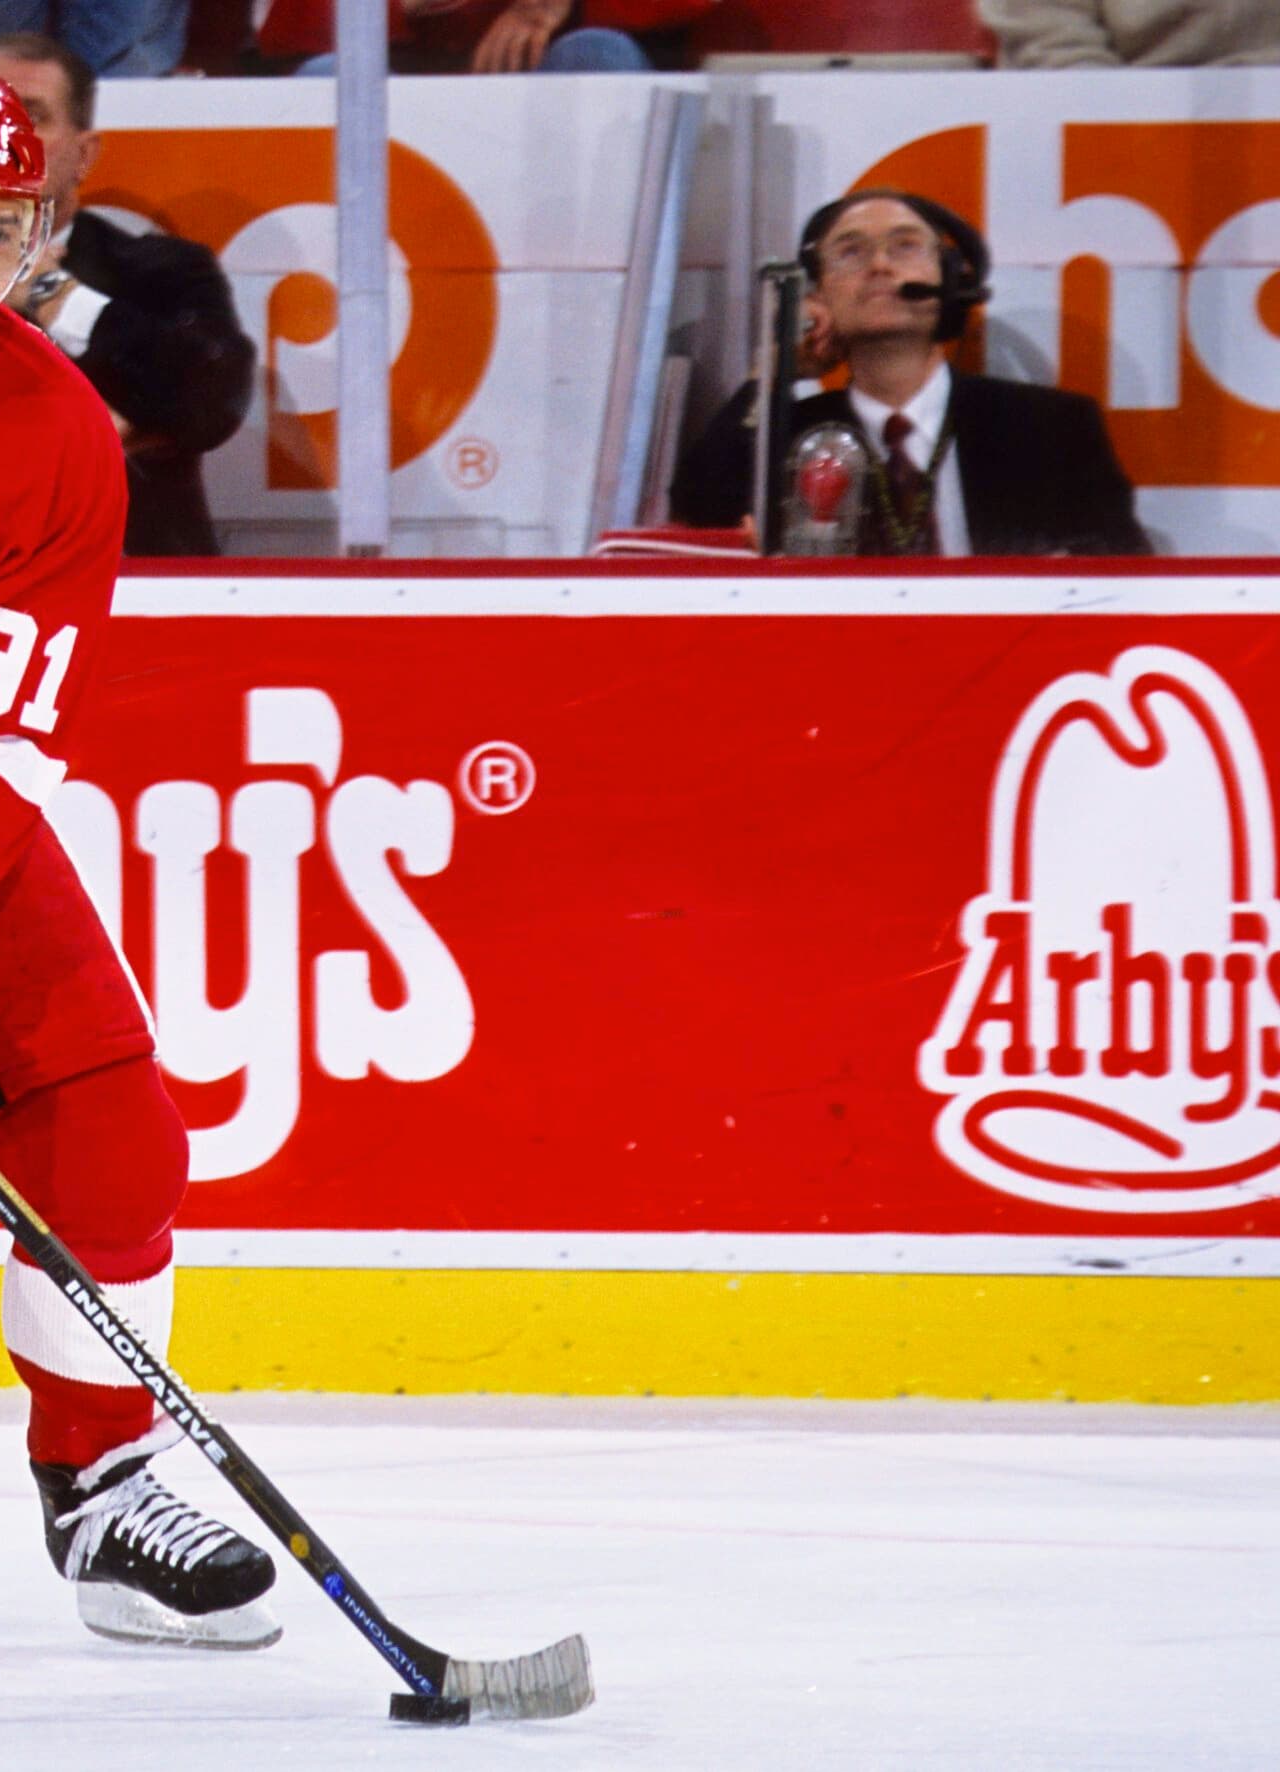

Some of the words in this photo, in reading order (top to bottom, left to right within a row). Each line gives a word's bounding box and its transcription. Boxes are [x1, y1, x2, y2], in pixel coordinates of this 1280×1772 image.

[944, 902, 1280, 1122] Arby'
[65, 1279, 228, 1465] INNOVATIVE
[344, 1594, 433, 1694] INNOVATIVE
